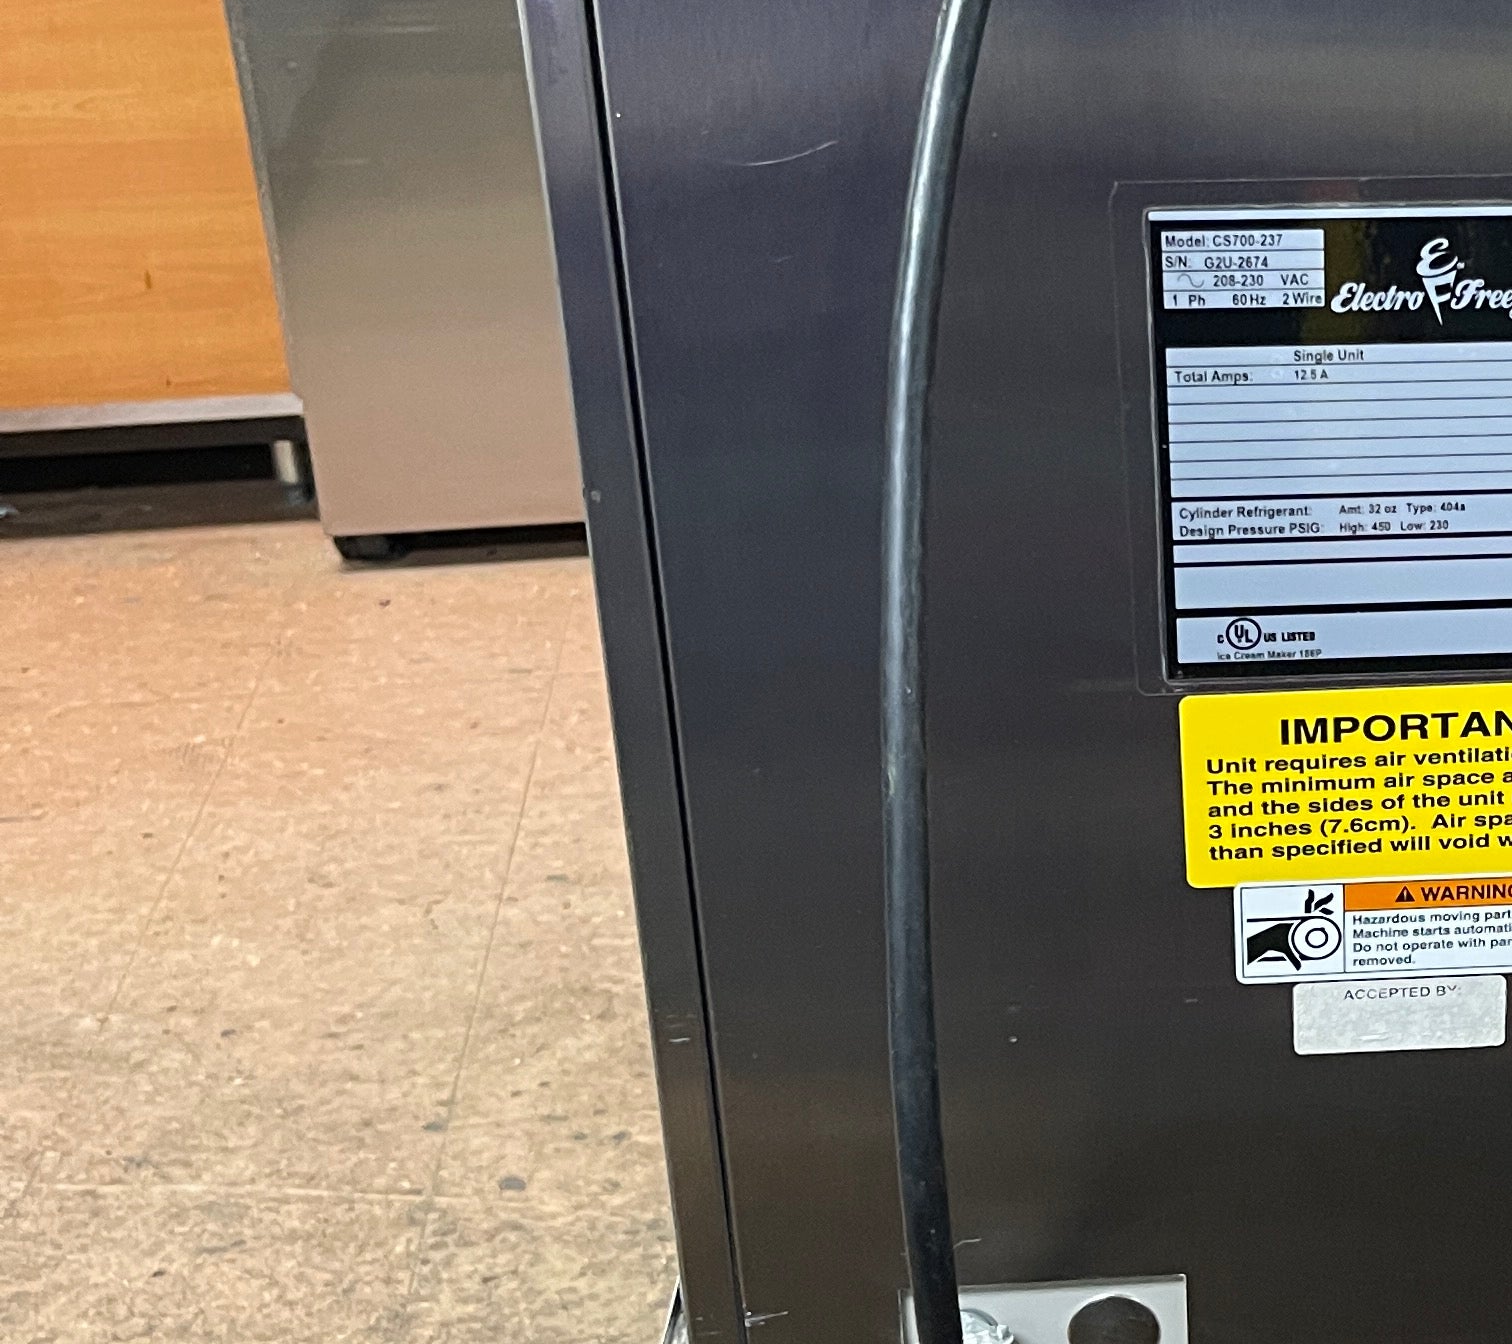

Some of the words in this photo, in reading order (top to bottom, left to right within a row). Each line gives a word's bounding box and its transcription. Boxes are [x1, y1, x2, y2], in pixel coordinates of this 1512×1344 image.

[1165, 235, 1210, 248] Model:
[1213, 234, 1283, 247] CS700-237
[1204, 256, 1269, 269] G2U-2674
[1213, 274, 1264, 287] 208-230
[1280, 274, 1309, 286] VAC
[1173, 294, 1178, 306] 1
[1189, 294, 1206, 305] Ph
[1293, 292, 1323, 305] Wire
[1330, 282, 1425, 313] Electro
[1293, 349, 1334, 364] Single
[1338, 348, 1364, 361] Unit
[1175, 370, 1207, 383] Total
[1211, 370, 1253, 385] Amps:
[1319, 368, 1329, 379] A
[1179, 507, 1233, 522] Cylinder
[1236, 505, 1312, 520] Refrigerant:
[1368, 503, 1381, 514] 32
[1384, 505, 1397, 514] oz
[1179, 525, 1224, 539] Design
[1228, 524, 1286, 535] Pressure
[1371, 521, 1391, 531] 450
[1281, 631, 1316, 642] LISTED
[1217, 652, 1231, 660] Ice
[1233, 651, 1265, 660] Cream
[1267, 650, 1296, 659] Maker
[1206, 757, 1257, 774] Unit
[1264, 754, 1367, 774] requires
[1374, 751, 1406, 767] air
[1206, 780, 1253, 796] The
[1261, 776, 1376, 793] minimum
[1383, 772, 1415, 788] air
[1422, 770, 1495, 789] space
[1208, 801, 1253, 818] and
[1261, 799, 1300, 815] the
[1308, 797, 1373, 814] sides
[1381, 794, 1405, 810] of
[1412, 793, 1451, 808] the
[1458, 790, 1504, 806] unit
[1208, 824, 1223, 839] 3
[1230, 821, 1312, 838] inches
[1320, 815, 1416, 838] (7.6cm).
[1431, 813, 1467, 829] Air
[1209, 845, 1263, 861] than
[1271, 837, 1382, 861] specified
[1390, 835, 1430, 852] will
[1439, 833, 1490, 850] void
[1352, 913, 1426, 925] Hazardous
[1430, 911, 1480, 923] moving
[1352, 927, 1409, 939] Machine
[1412, 925, 1450, 937] starts
[1352, 942, 1371, 953] Do
[1376, 942, 1398, 952] not
[1402, 938, 1454, 953] operate
[1457, 937, 1486, 948] with
[1352, 955, 1416, 967] removed.
[1344, 986, 1431, 1001] ACCEPTED
